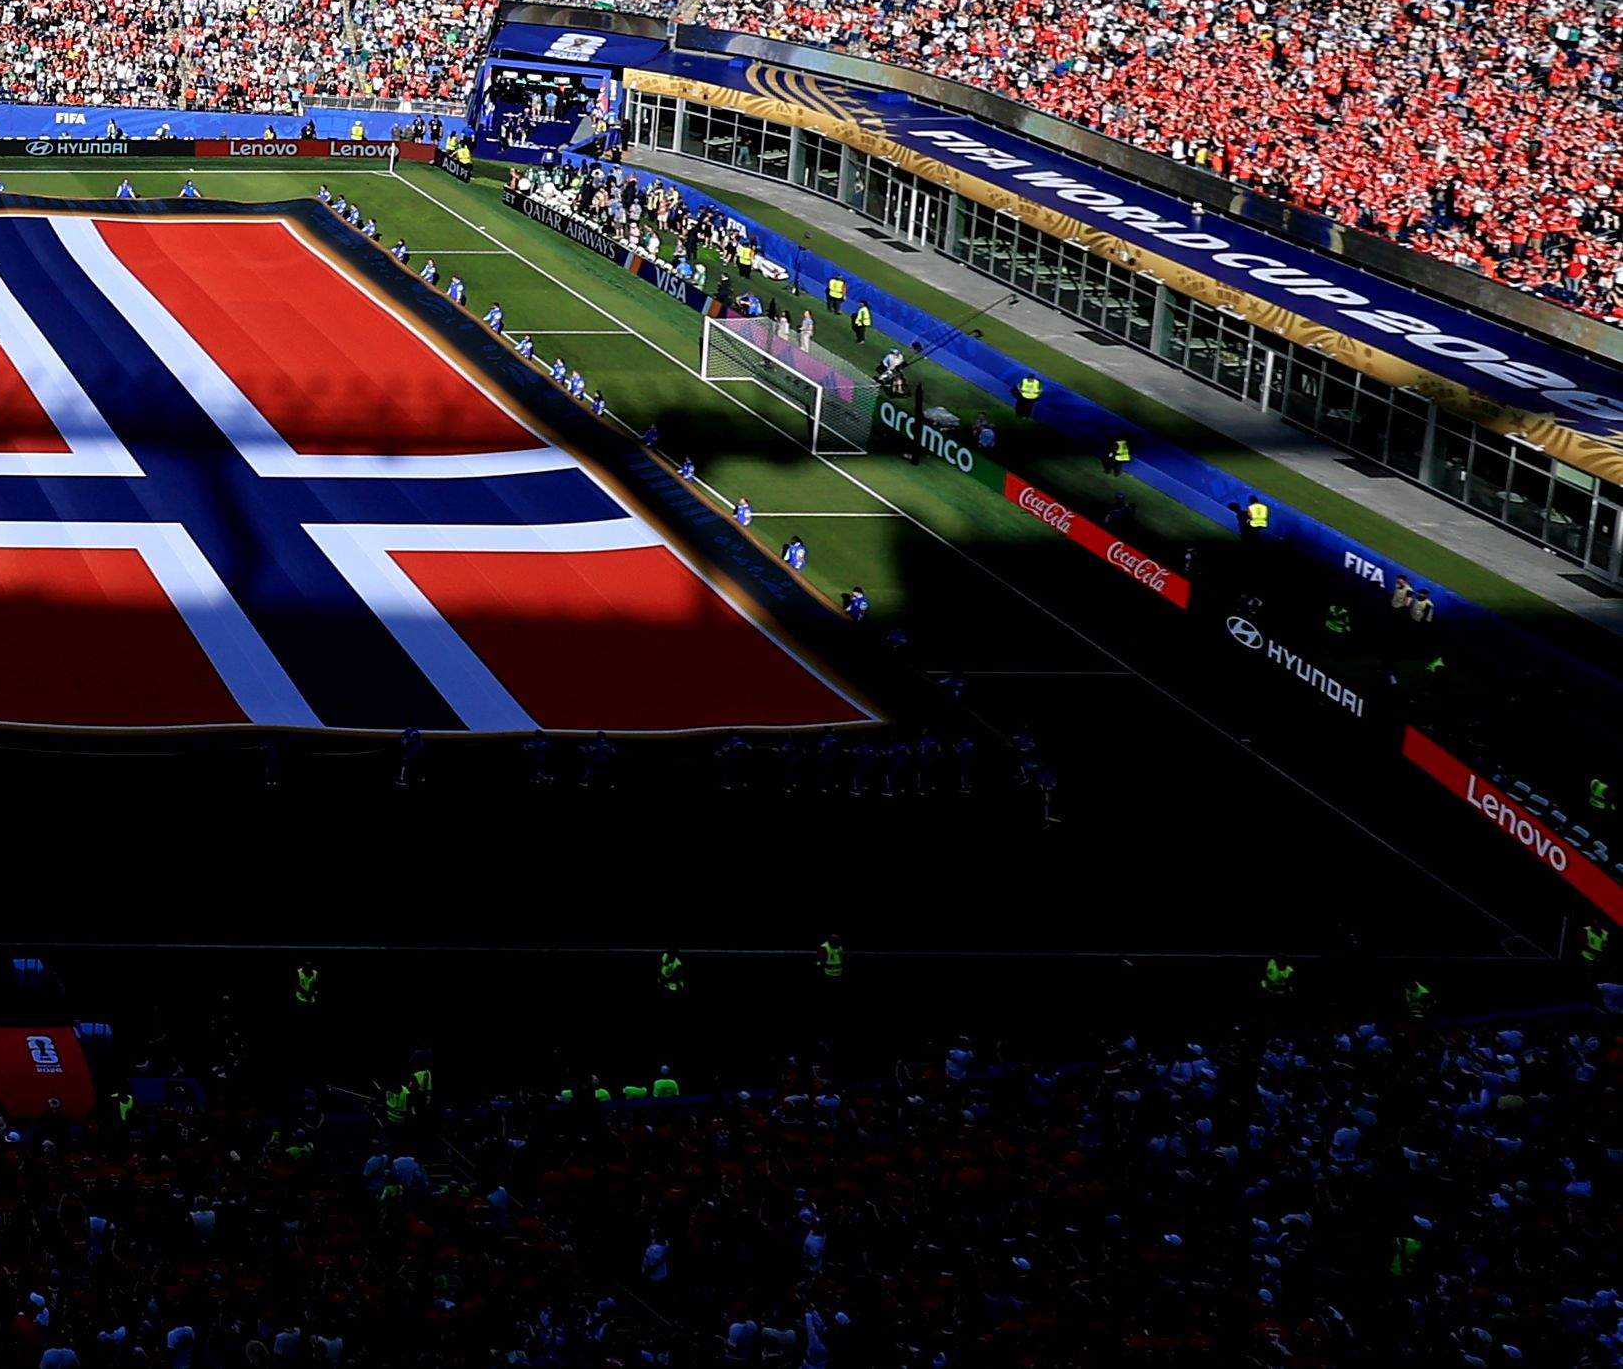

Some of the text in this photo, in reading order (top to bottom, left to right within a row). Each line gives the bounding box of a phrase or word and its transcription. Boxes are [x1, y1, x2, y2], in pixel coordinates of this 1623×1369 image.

[55, 112, 87, 125] FIFA
[57, 143, 128, 155] HYUNDAI
[230, 141, 298, 156] Lenovo
[330, 141, 400, 157] Lenovo
[442, 157, 460, 175] ADI
[523, 199, 616, 259] QATAR AIRWAYS
[727, 217, 748, 239] FIFA
[655, 267, 687, 304] VISA
[908, 130, 1623, 422] FIFA WORLD CUP 2026
[1344, 551, 1386, 589] FIFA
[1267, 639, 1364, 718] HYUNDAI
[1466, 774, 1568, 871] Lenovo
